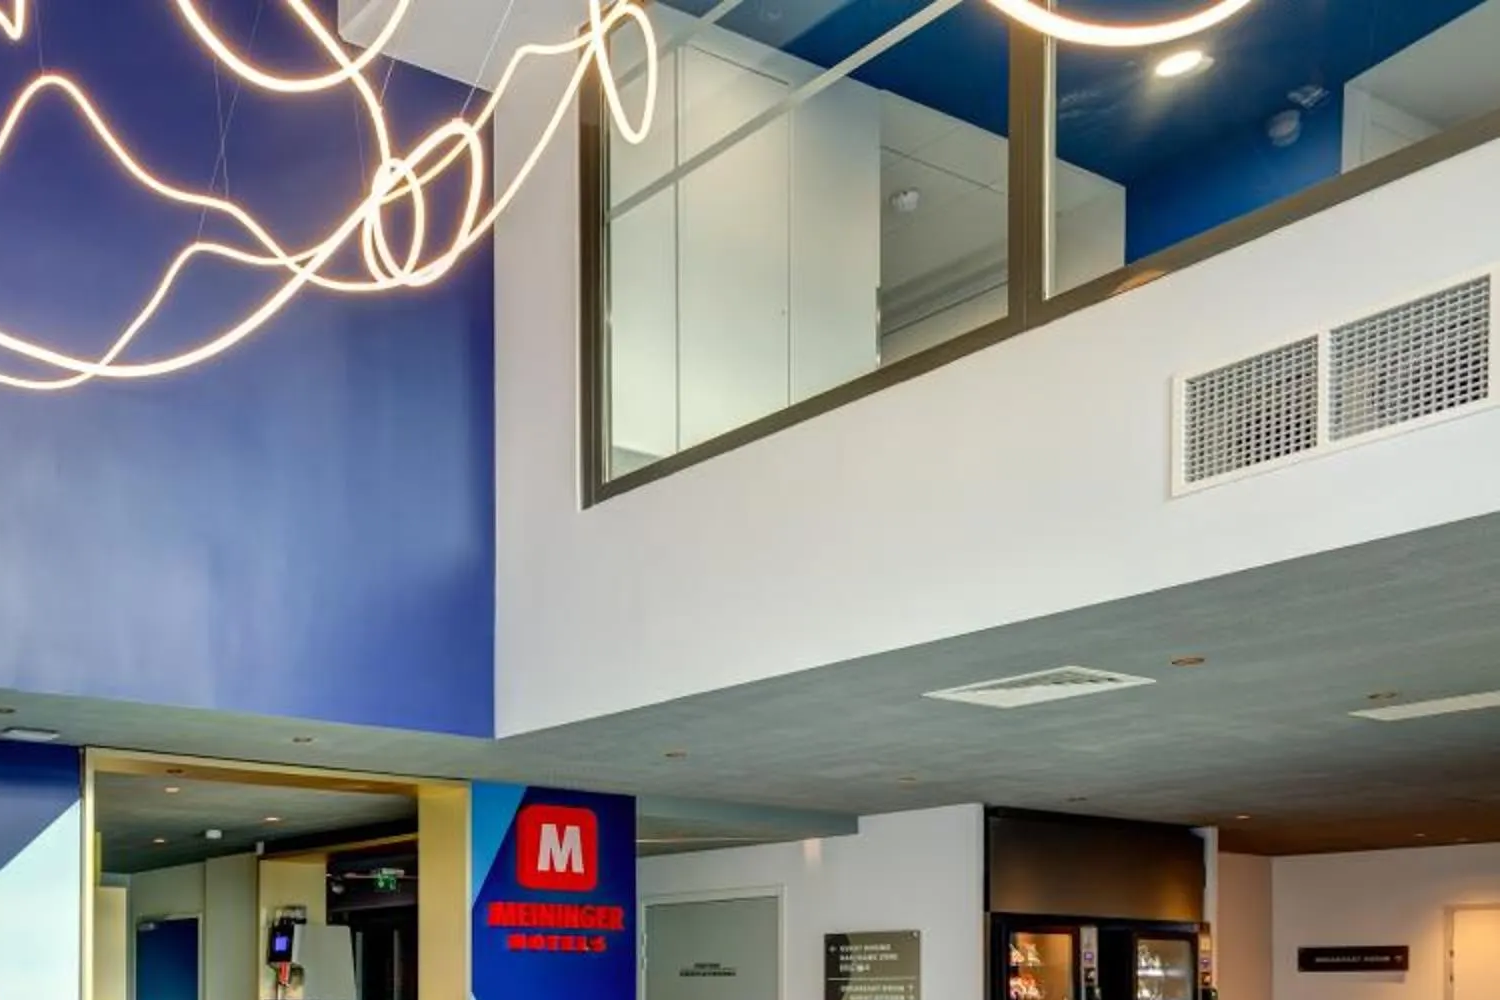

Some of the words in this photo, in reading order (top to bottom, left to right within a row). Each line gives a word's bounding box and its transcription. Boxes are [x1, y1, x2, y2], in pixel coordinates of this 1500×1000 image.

[537, 823, 584, 874] M
[487, 901, 625, 931] MEININGER
[507, 933, 607, 952] HOTELS
